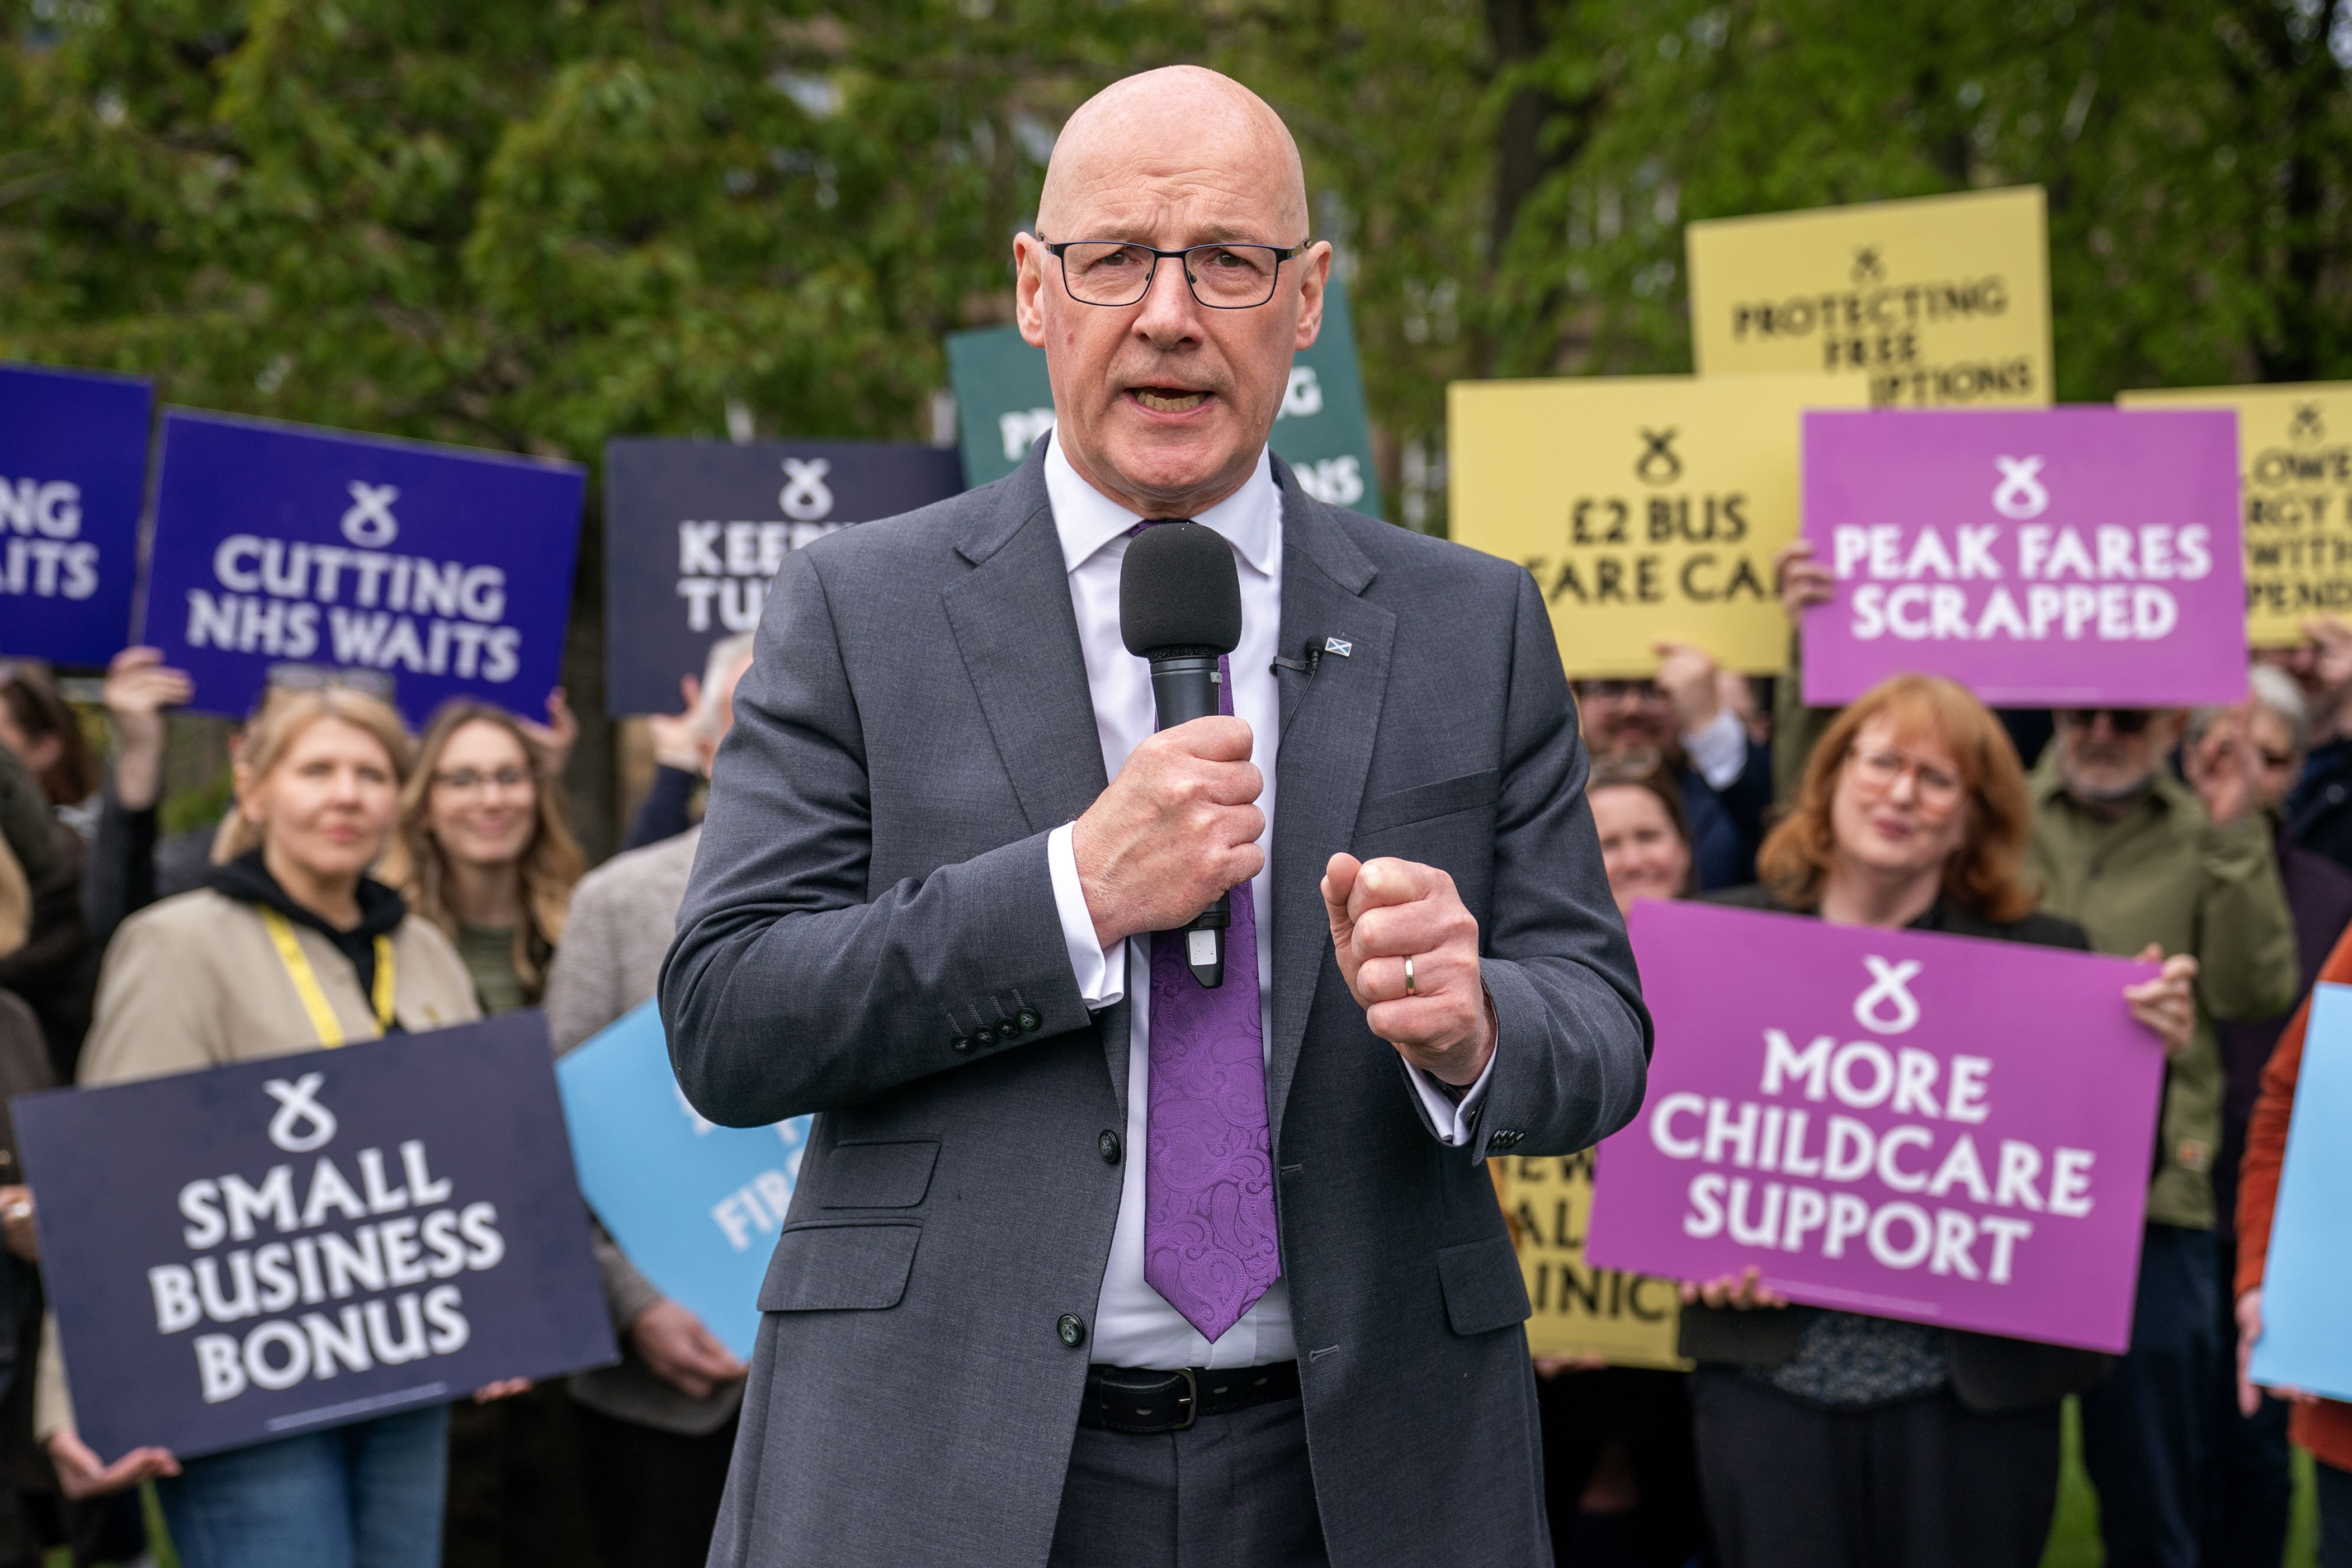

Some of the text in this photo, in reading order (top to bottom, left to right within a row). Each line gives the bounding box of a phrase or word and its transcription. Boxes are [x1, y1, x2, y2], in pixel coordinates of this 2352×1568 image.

[1731, 276, 2009, 339] PROTECTING
[1823, 330, 1918, 370] FREE
[1569, 492, 1750, 547] £2 BUS
[1833, 523, 2212, 581] PEAK FARES
[212, 533, 506, 624] CUTTING
[1850, 583, 2179, 641] SCRAPPED
[186, 587, 521, 683] NHS WAITS
[1759, 1028, 1993, 1125] MORE
[178, 1139, 453, 1250] SMALL
[1649, 1091, 2096, 1218] CHILDCARE
[148, 1199, 506, 1335] BUSINESS
[1683, 1172, 2033, 1286] SUPPORT
[193, 1284, 470, 1405] BONUS
